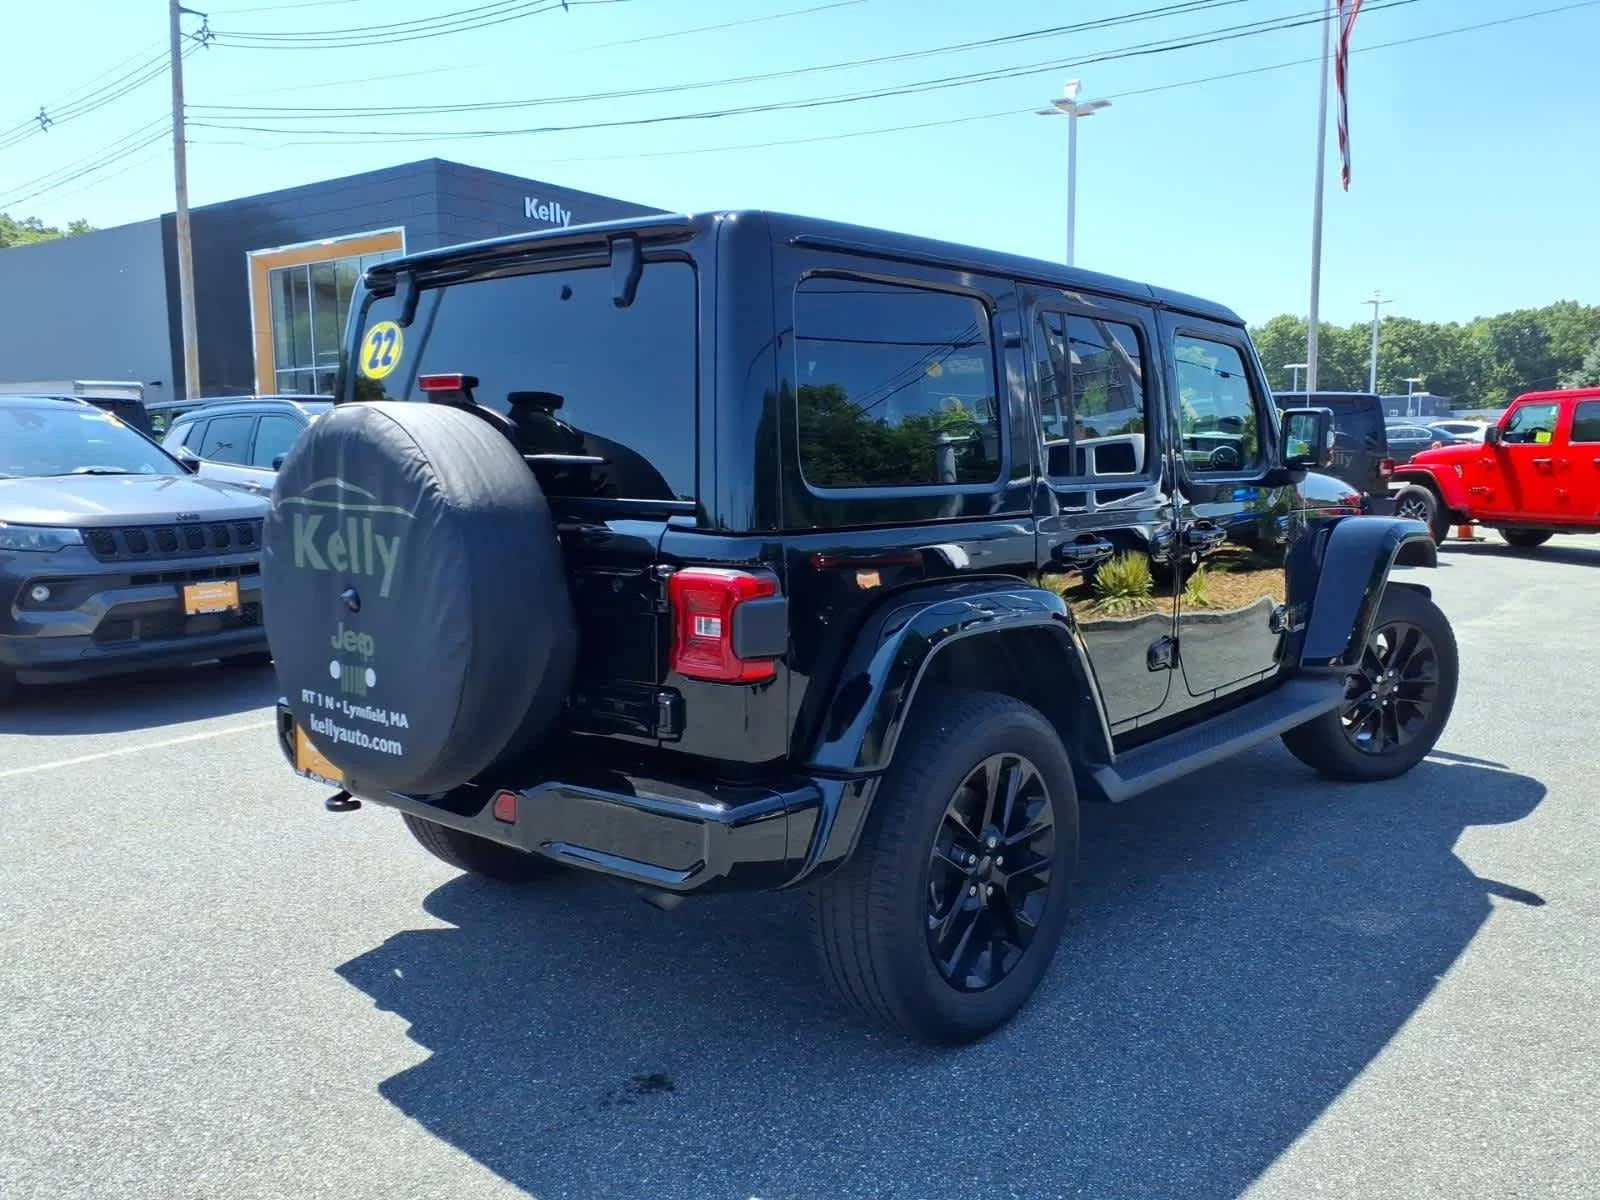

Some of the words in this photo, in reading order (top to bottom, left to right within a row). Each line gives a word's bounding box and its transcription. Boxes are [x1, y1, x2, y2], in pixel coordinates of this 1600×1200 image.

[524, 196, 571, 227] Kelly
[368, 328, 396, 370] 22
[293, 512, 400, 598] Kelly
[331, 621, 374, 661] Jeep
[302, 689, 316, 704] RT
[317, 692, 323, 707] 1
[325, 695, 335, 710] N
[390, 711, 409, 729] MA
[309, 713, 403, 756] kellyauto.com
